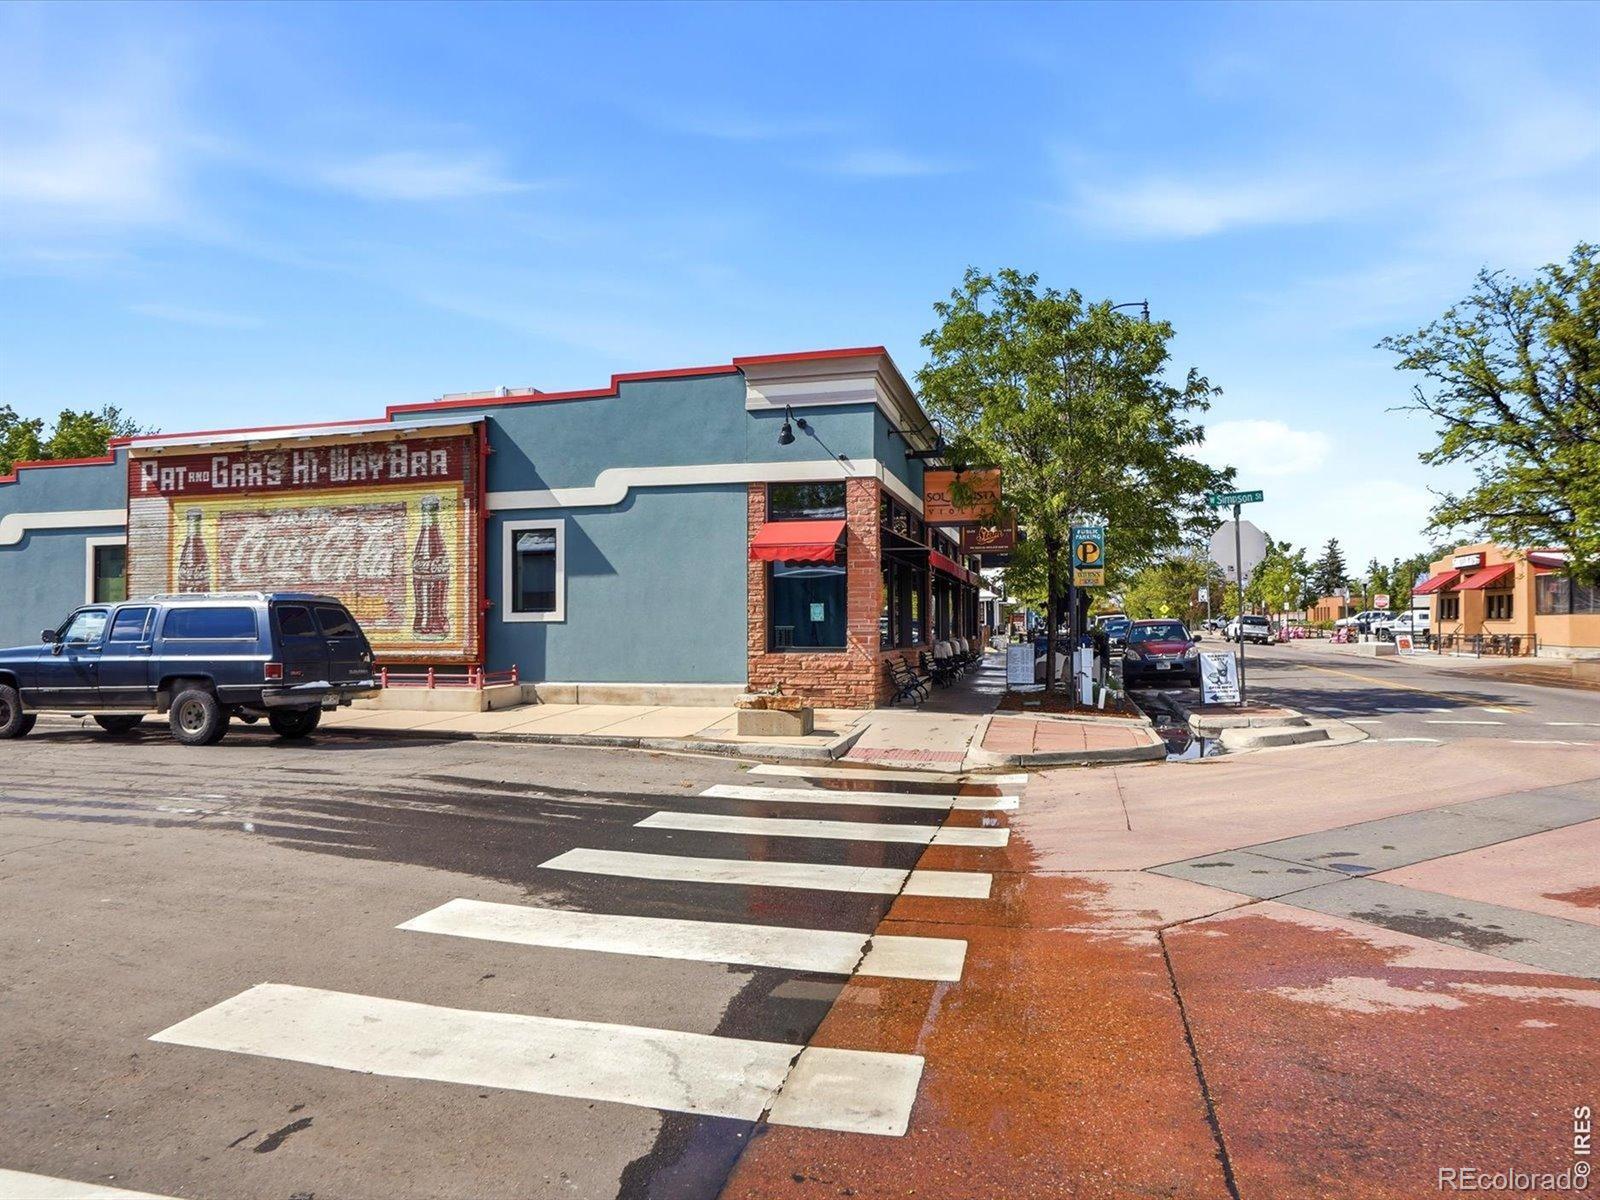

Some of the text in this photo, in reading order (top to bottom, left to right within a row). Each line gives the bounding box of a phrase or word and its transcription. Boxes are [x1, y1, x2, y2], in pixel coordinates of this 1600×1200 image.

[141, 460, 187, 491] PAT
[188, 471, 210, 482] AND
[926, 492, 951, 502] SOL
[1216, 493, 1253, 505] Simpson
